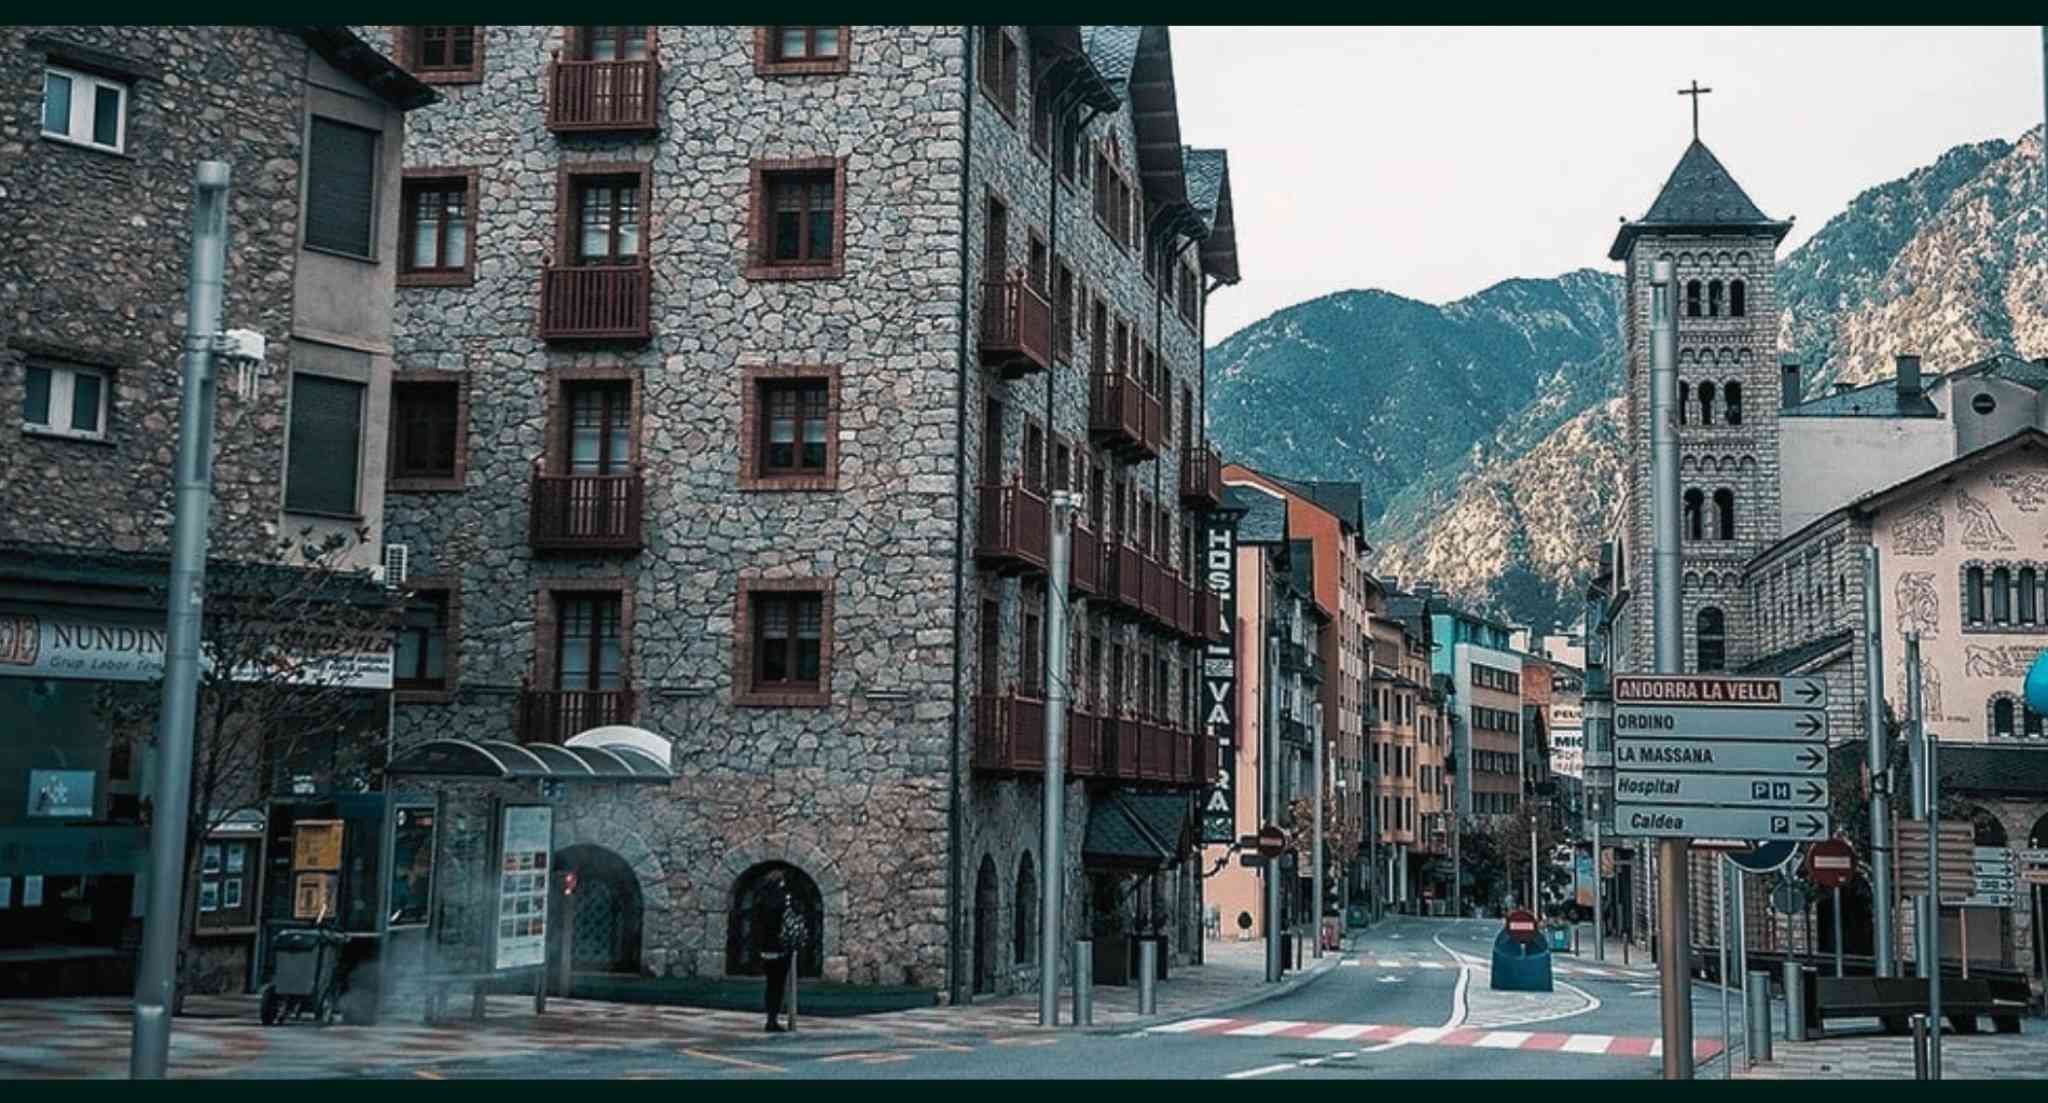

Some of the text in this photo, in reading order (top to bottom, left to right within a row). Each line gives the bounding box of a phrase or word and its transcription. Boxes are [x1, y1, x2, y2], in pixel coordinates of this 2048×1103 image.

[1619, 681, 1778, 700] ANDORRA LA VELLA
[1617, 714, 1675, 730] ORDINO
[1617, 747, 1713, 763] LA MASSANA
[1617, 777, 1681, 797] Hospital
[1754, 784, 1767, 798] P
[1631, 812, 1787, 831] Caldea P
